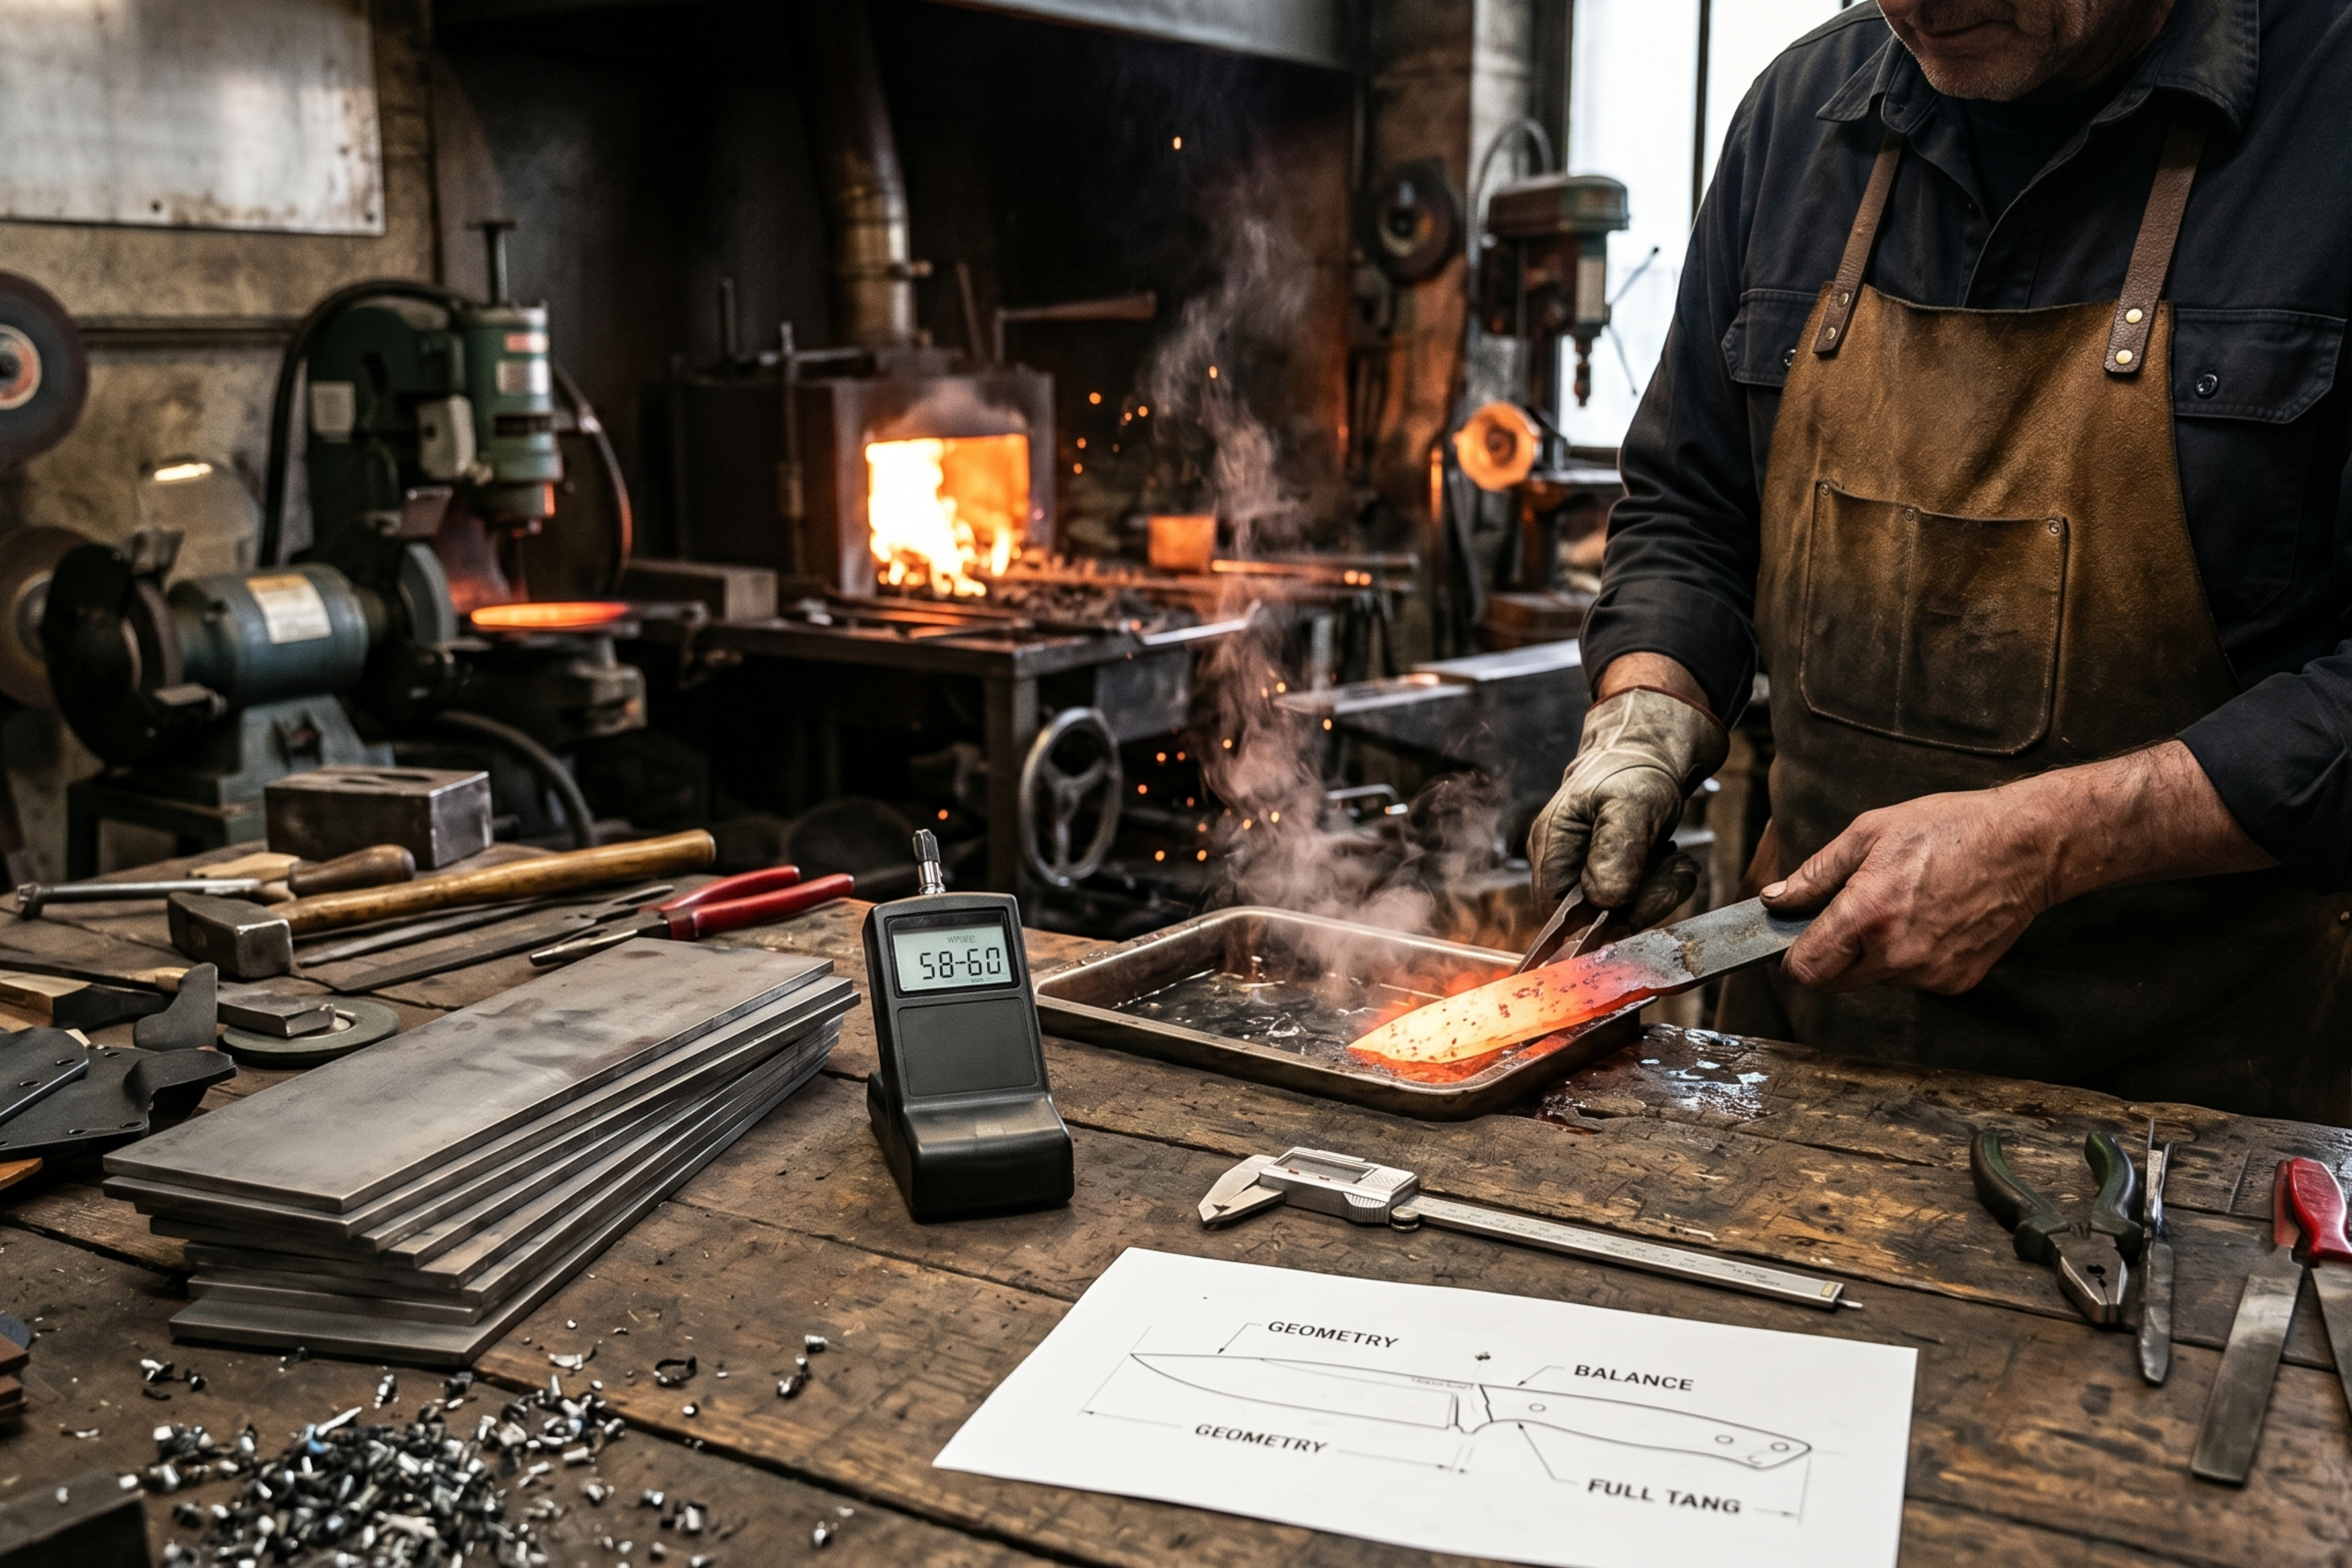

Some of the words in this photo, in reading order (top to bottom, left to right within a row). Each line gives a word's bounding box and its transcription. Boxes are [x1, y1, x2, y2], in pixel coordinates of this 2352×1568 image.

[920, 947, 1001, 980] 58-60
[1267, 1321, 1399, 1348] GEOMETRY
[1574, 1365, 1694, 1391] BALANCE
[1194, 1425, 1327, 1453] GEOMETRY
[1588, 1479, 1653, 1502] FULL
[1665, 1490, 1741, 1514] TANG
